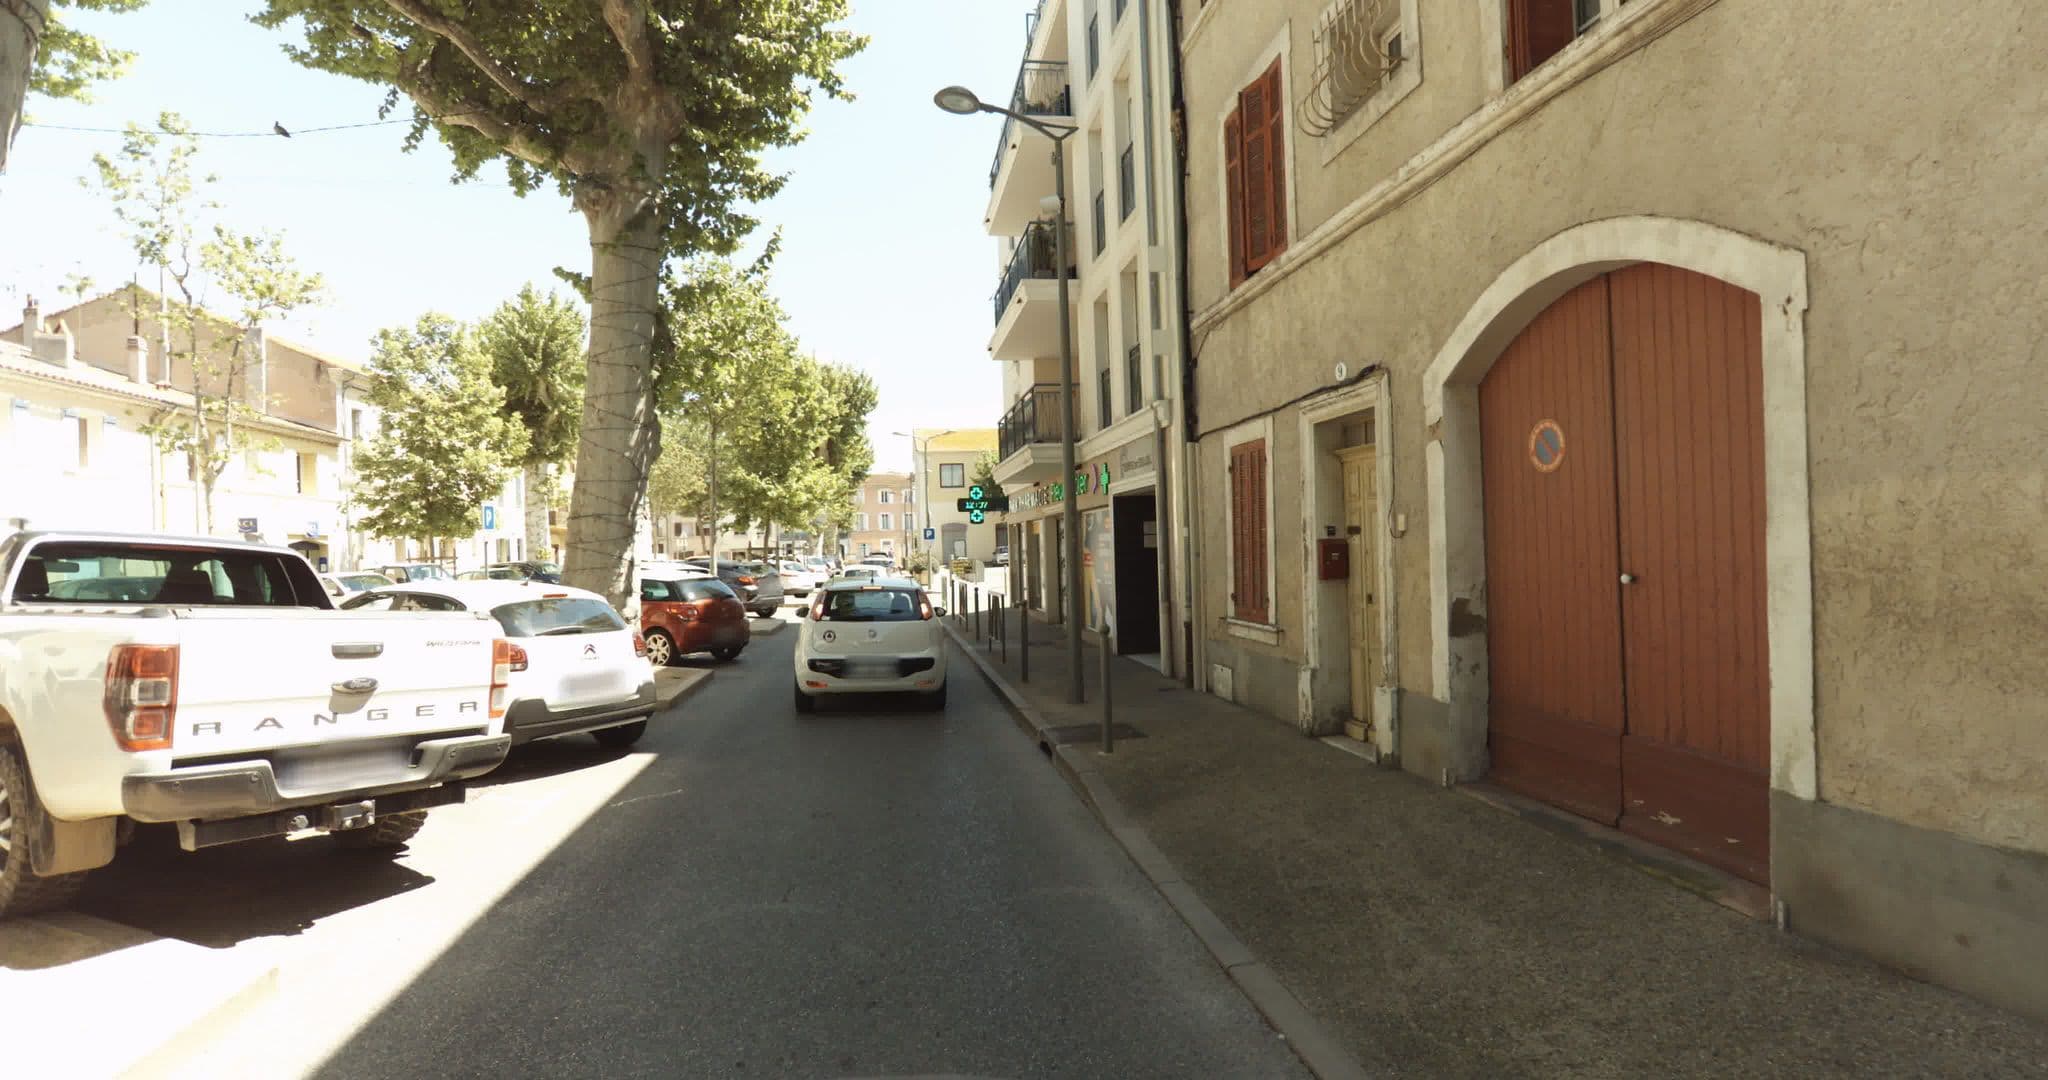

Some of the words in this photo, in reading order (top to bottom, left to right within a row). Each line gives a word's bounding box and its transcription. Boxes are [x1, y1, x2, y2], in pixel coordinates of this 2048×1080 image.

[486, 509, 493, 527] P
[926, 530, 933, 538] P
[192, 700, 479, 737] RANGER
